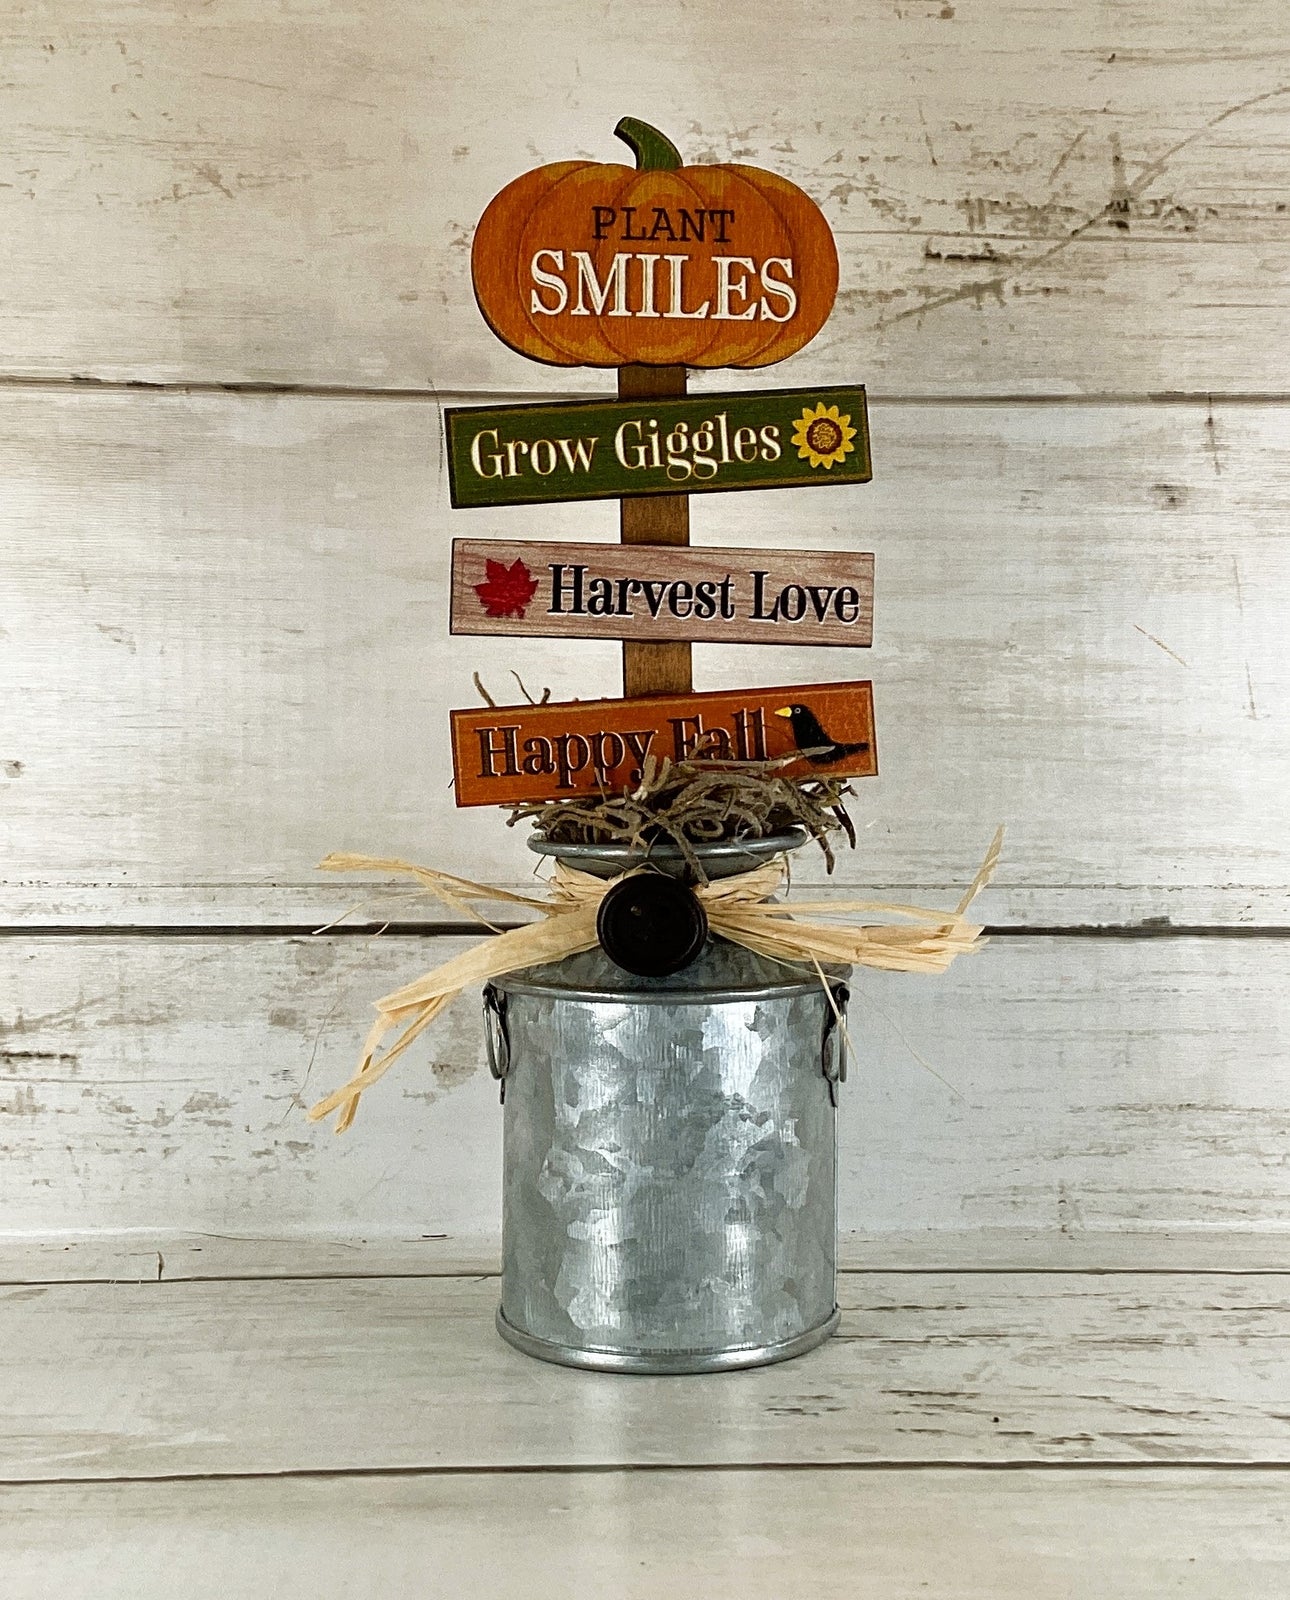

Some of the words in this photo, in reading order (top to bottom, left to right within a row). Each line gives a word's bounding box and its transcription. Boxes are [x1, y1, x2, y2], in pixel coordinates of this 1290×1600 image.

[591, 206, 735, 242] PLANT
[530, 249, 797, 322] SMILES
[470, 428, 599, 479] Grow
[614, 411, 782, 481] Giggles
[547, 563, 735, 620] Harvest
[748, 570, 860, 624] Love
[473, 724, 658, 789] Happy
[667, 706, 770, 762] Fall
